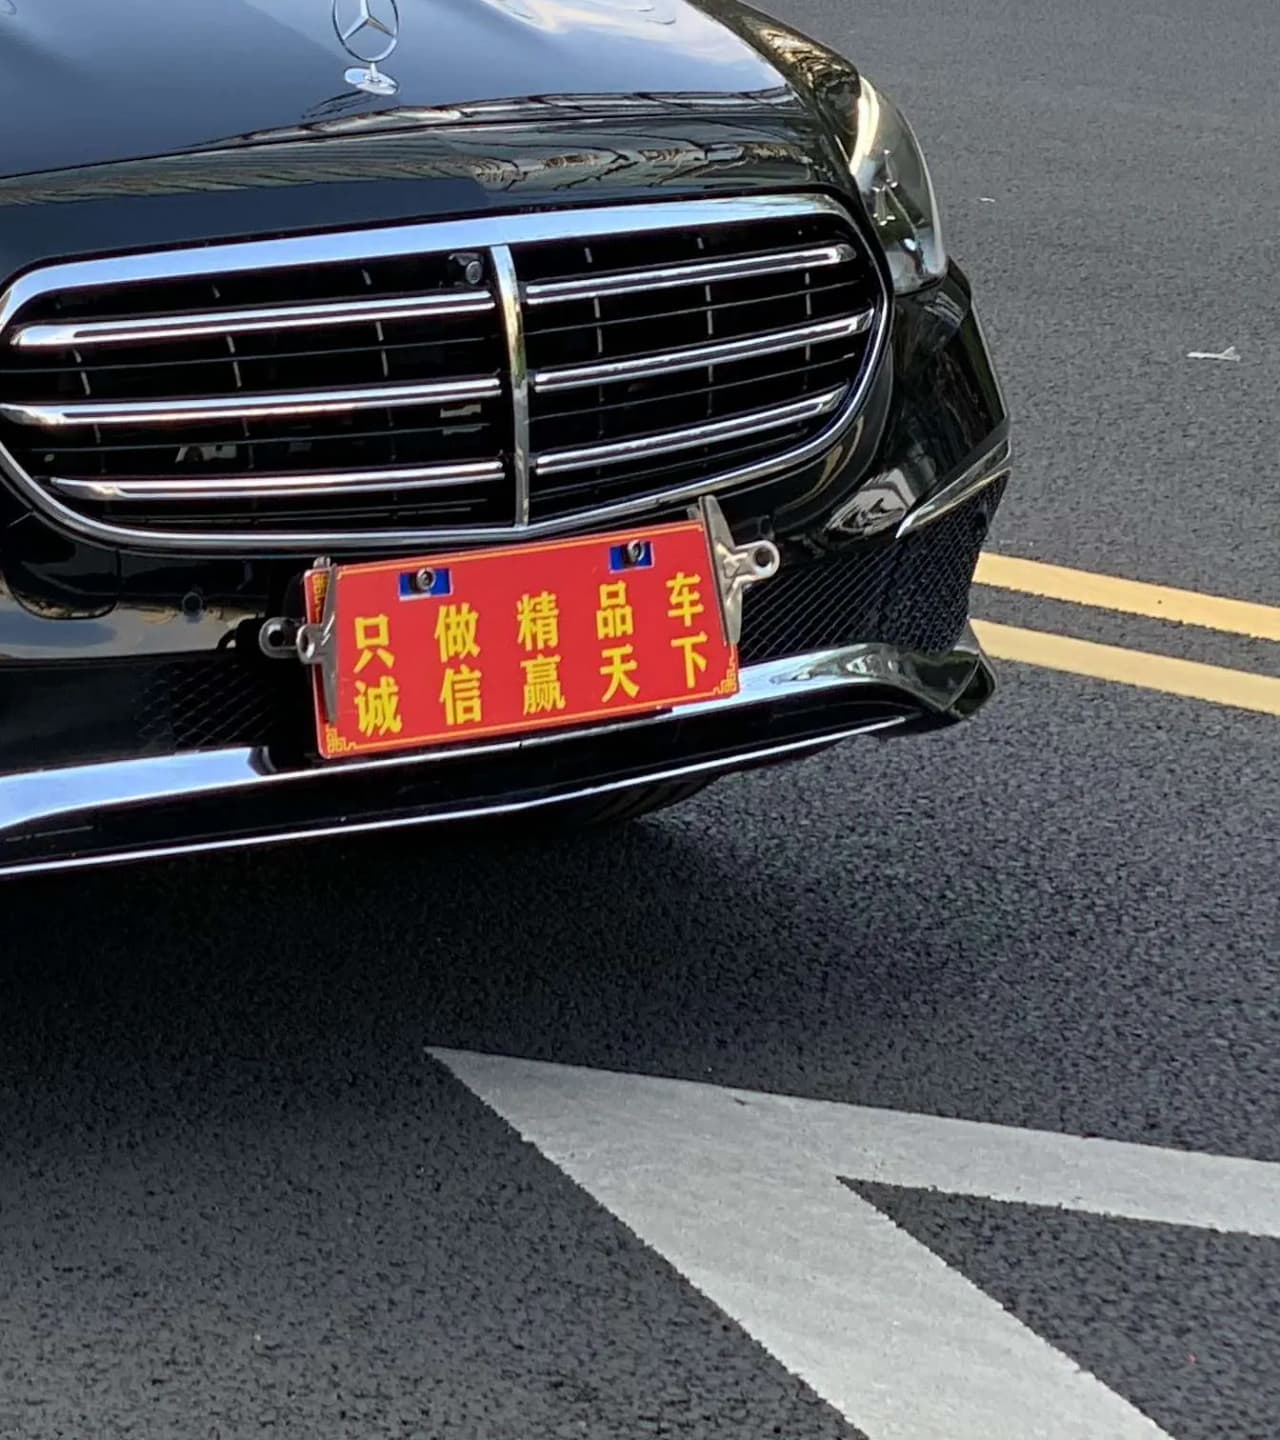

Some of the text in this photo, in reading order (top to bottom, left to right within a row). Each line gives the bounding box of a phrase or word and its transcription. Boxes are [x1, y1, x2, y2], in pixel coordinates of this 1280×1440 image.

[353, 571, 705, 674] 只做精品车
[353, 631, 709, 738] 诚信赢天下
